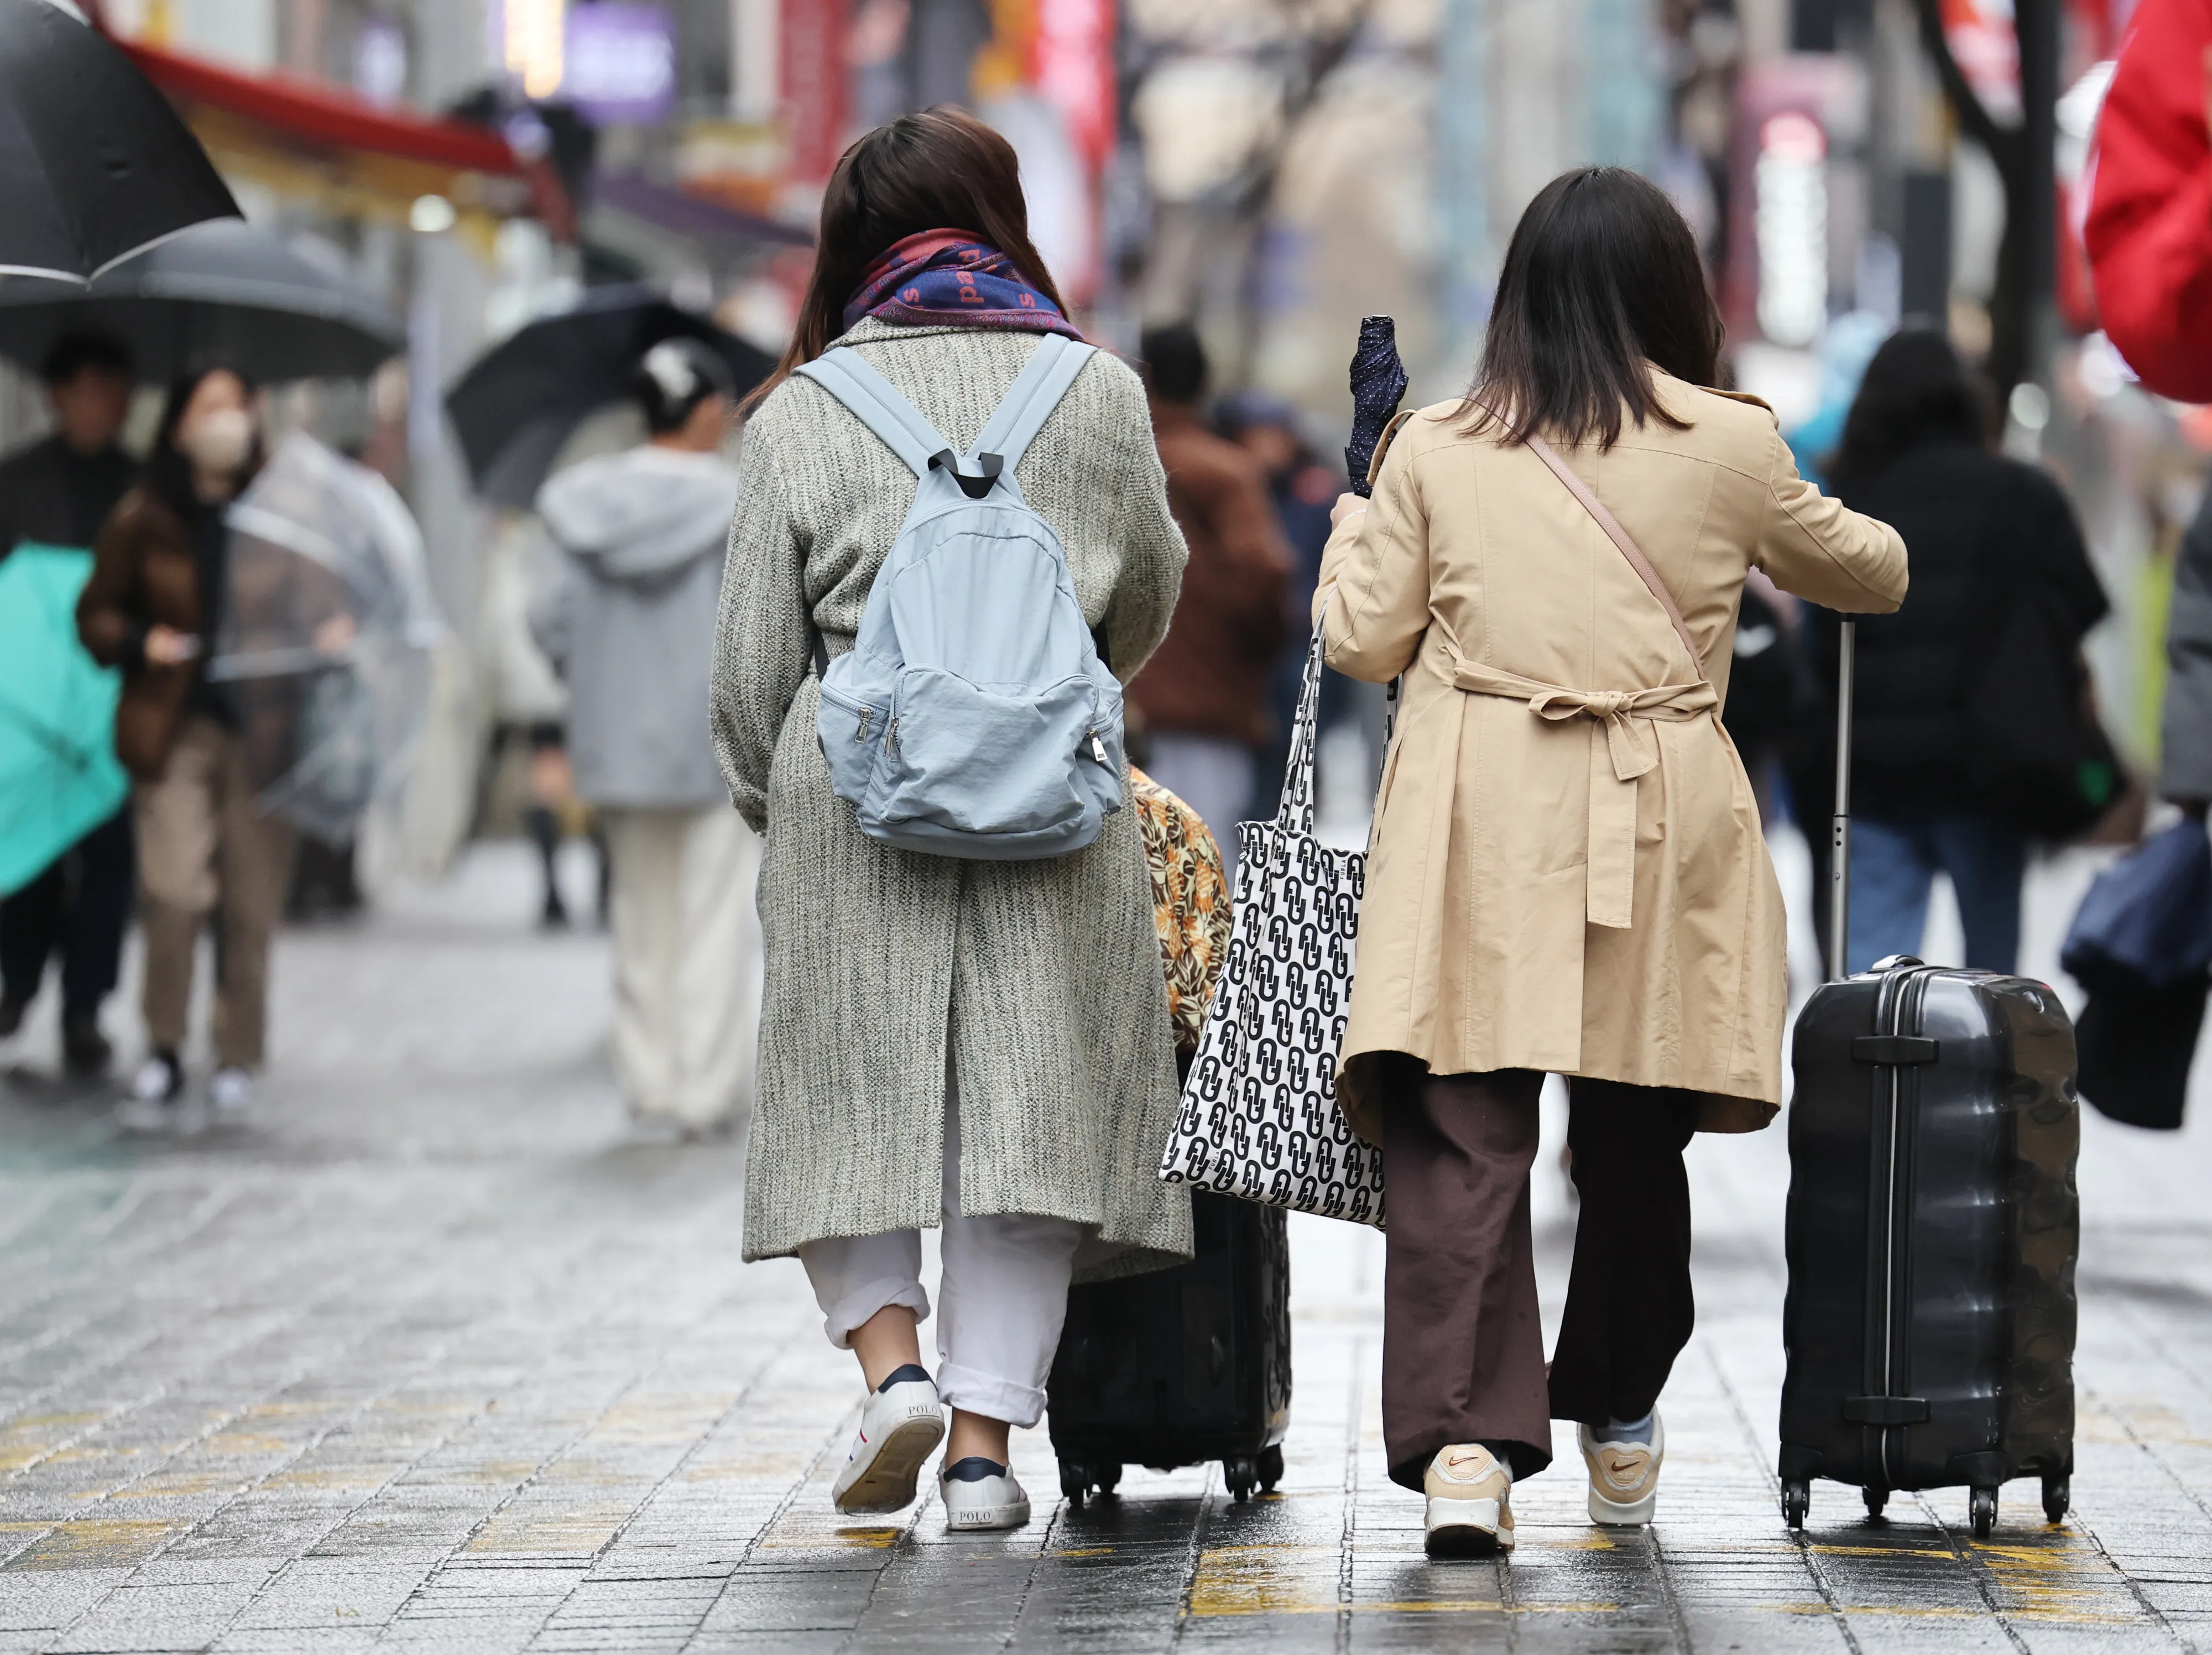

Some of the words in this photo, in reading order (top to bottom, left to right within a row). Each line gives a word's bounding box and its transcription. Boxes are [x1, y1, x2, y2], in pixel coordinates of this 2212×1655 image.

[1208, 1151, 1219, 1171] FURLA
[909, 1405, 937, 1415] POLO
[960, 1511, 990, 1521] POLO
